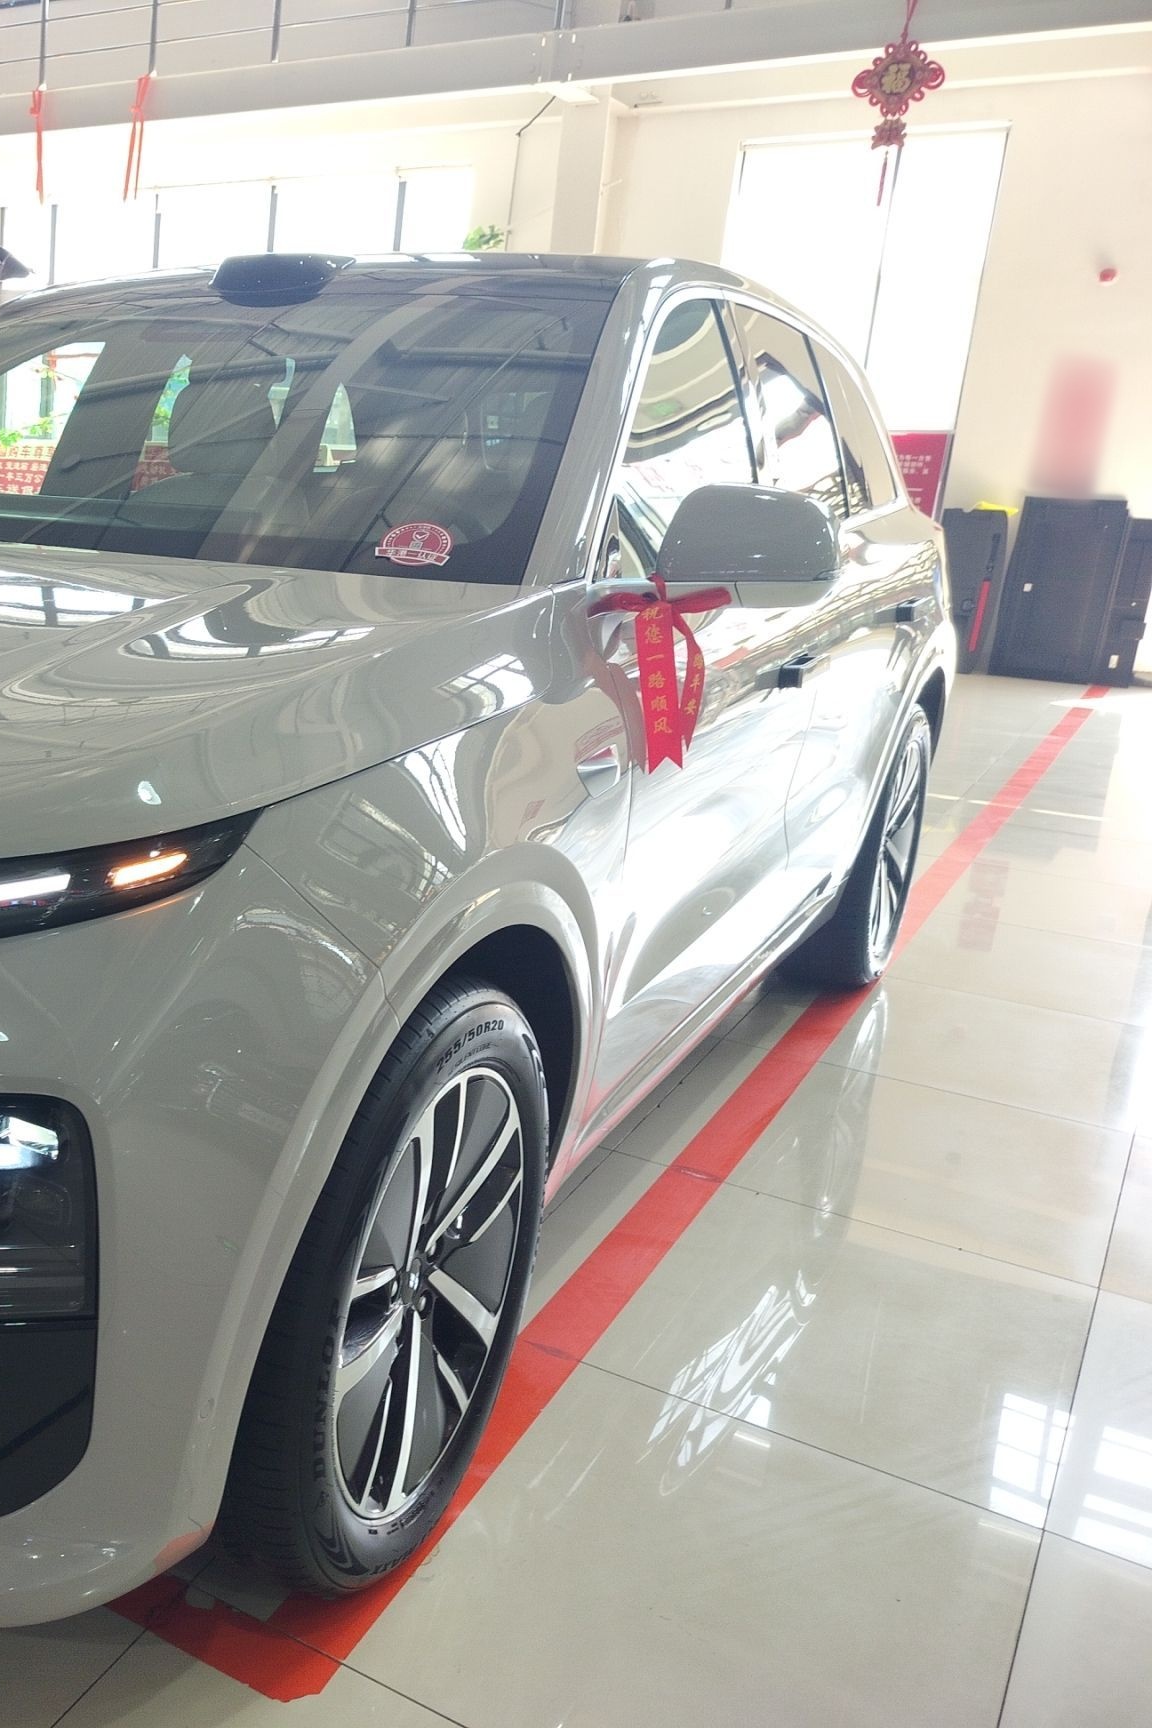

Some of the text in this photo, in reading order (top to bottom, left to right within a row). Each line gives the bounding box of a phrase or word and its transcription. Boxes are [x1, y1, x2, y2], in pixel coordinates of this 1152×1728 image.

[880, 62, 912, 95] 福
[641, 606, 673, 735] 祝您一路顺风
[436, 1019, 505, 1075] 255/50R20
